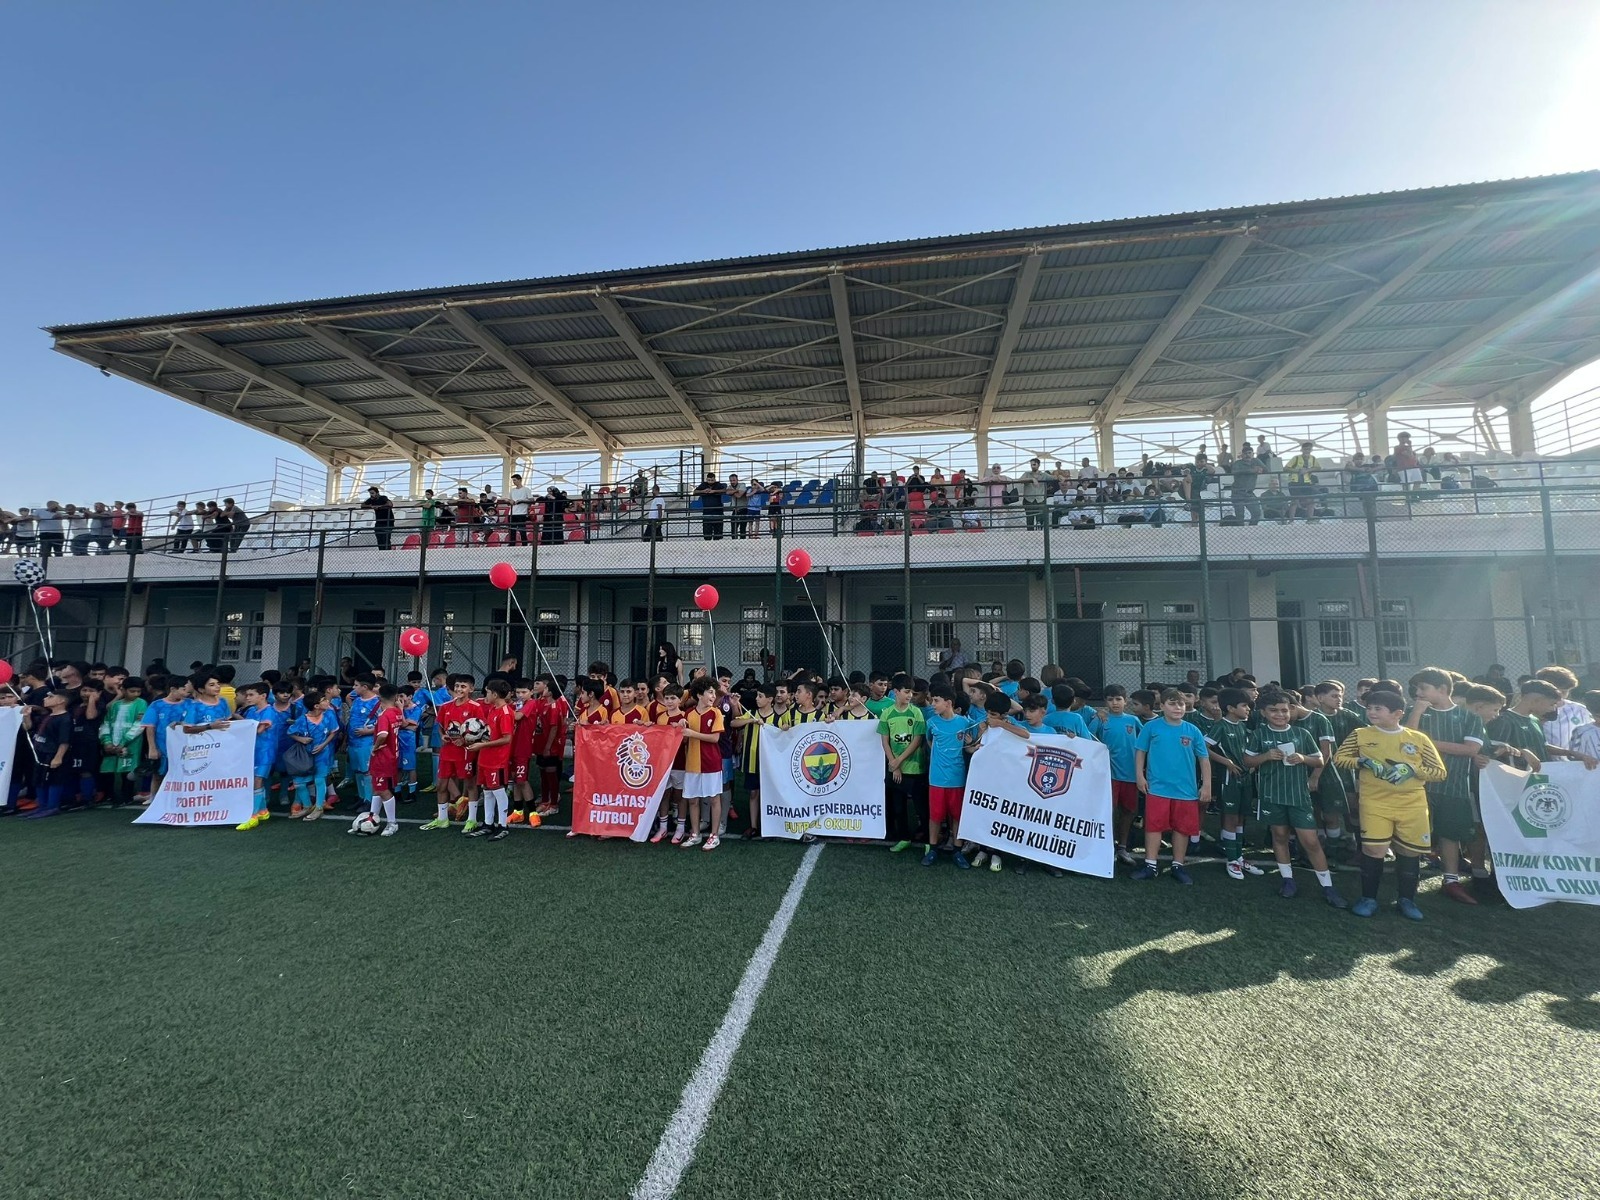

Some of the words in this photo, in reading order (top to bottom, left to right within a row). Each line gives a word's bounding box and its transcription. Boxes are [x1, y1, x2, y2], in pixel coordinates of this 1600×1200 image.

[819, 732, 840, 746] SPOR
[490, 772, 498, 781] 7
[516, 765, 526, 774] 22
[183, 781, 195, 792] 10
[199, 777, 248, 791] NUMARA
[813, 784, 830, 794] 1907
[194, 810, 229, 823] OKULU
[589, 810, 635, 825] FUTBOL
[766, 804, 810, 818] BATMAN
[813, 802, 882, 819] FENERBAHÇE
[968, 789, 1000, 811] 1955
[1000, 799, 1052, 826] BATMAN
[1054, 813, 1106, 839] BELEDİYE
[823, 817, 862, 831] OKULU
[990, 821, 1025, 844] SPOR
[1026, 831, 1077, 859] KULÜBÜ
[1492, 852, 1540, 869] BATMAN
[1505, 875, 1556, 892] FUTBOL
